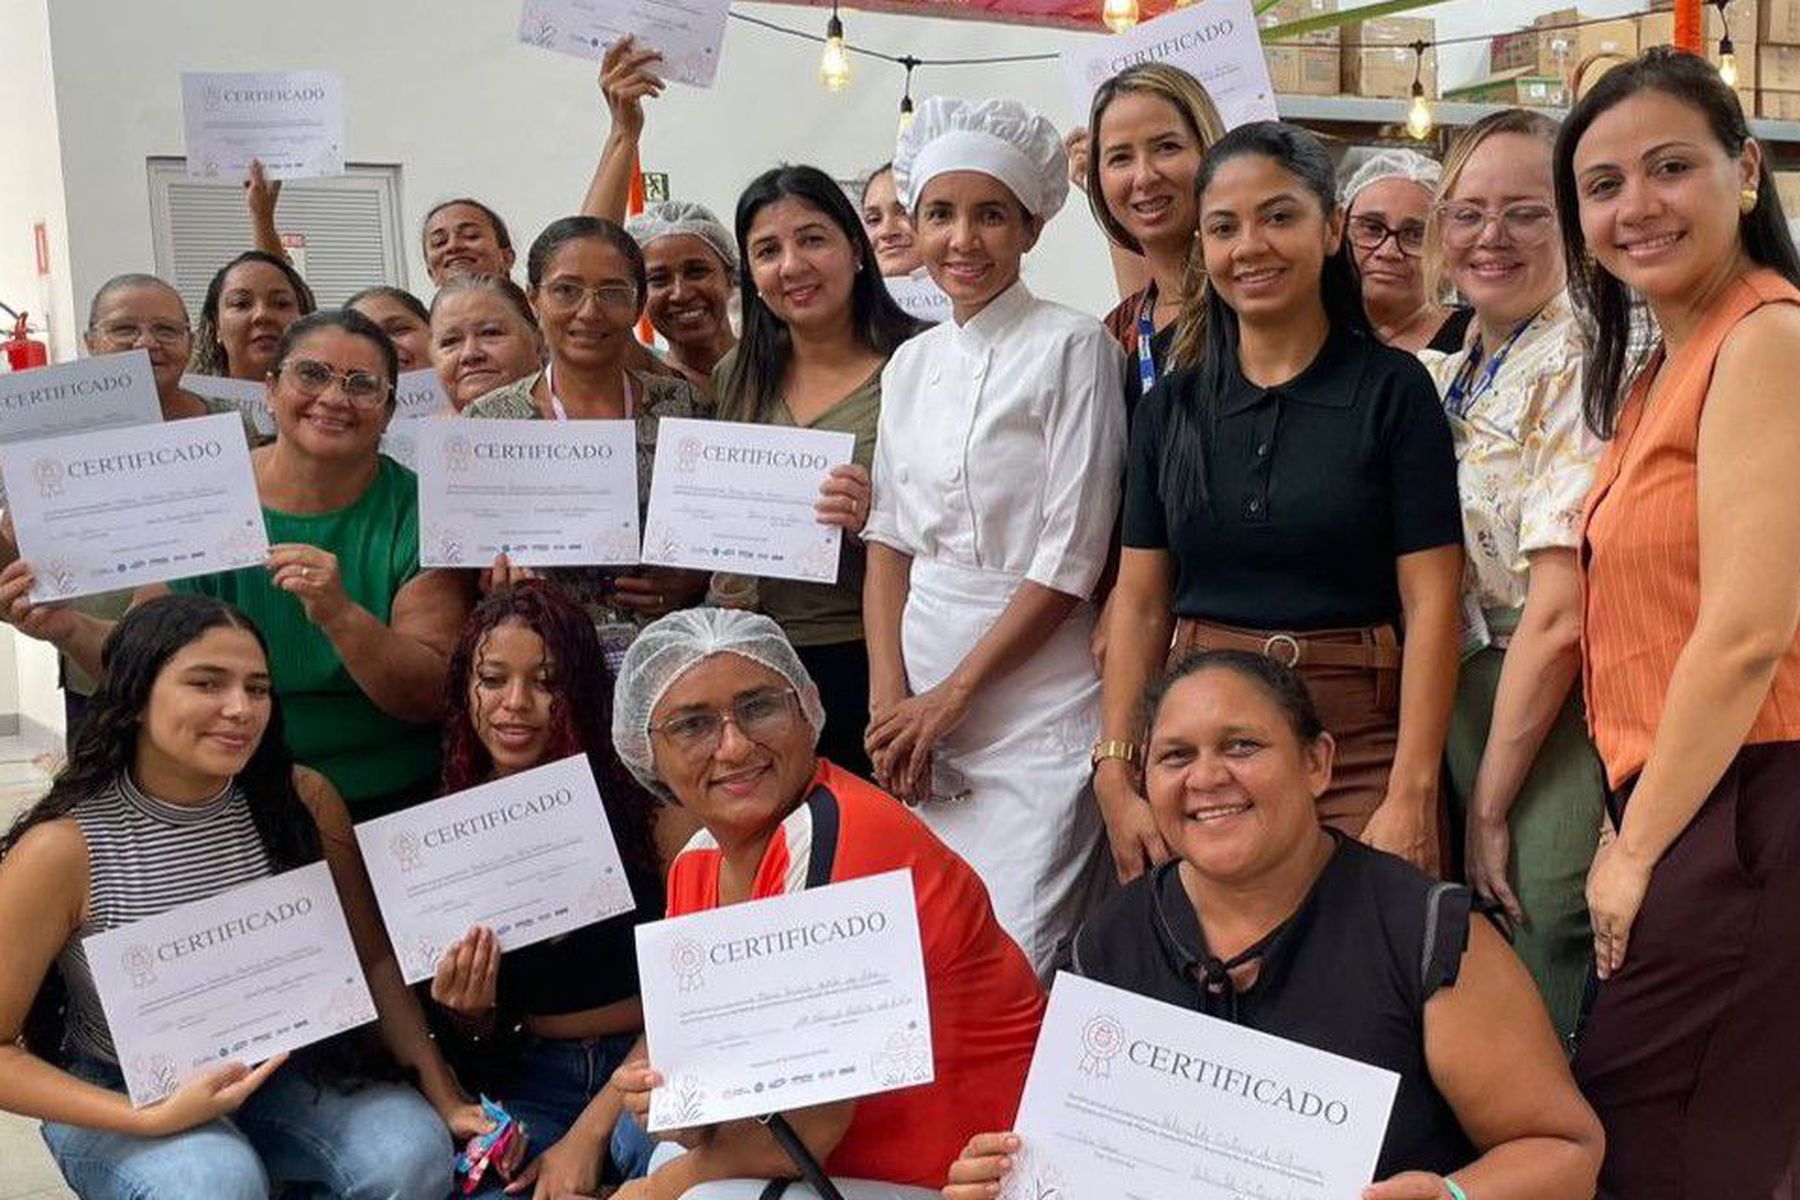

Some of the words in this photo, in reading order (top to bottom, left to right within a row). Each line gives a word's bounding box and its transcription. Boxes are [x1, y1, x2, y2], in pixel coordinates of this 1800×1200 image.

[1110, 19, 1234, 73] CERTIFICADO
[68, 440, 222, 478] CERTIFICADO
[474, 442, 613, 461] CERTIFICADO
[703, 445, 828, 471] CERTIFICADO
[424, 788, 572, 848] CERTIFICADO
[158, 897, 313, 962] CERTIFICADO
[709, 911, 887, 966] CERTIFICADO
[1128, 1039, 1349, 1126] CERTIFICADO
